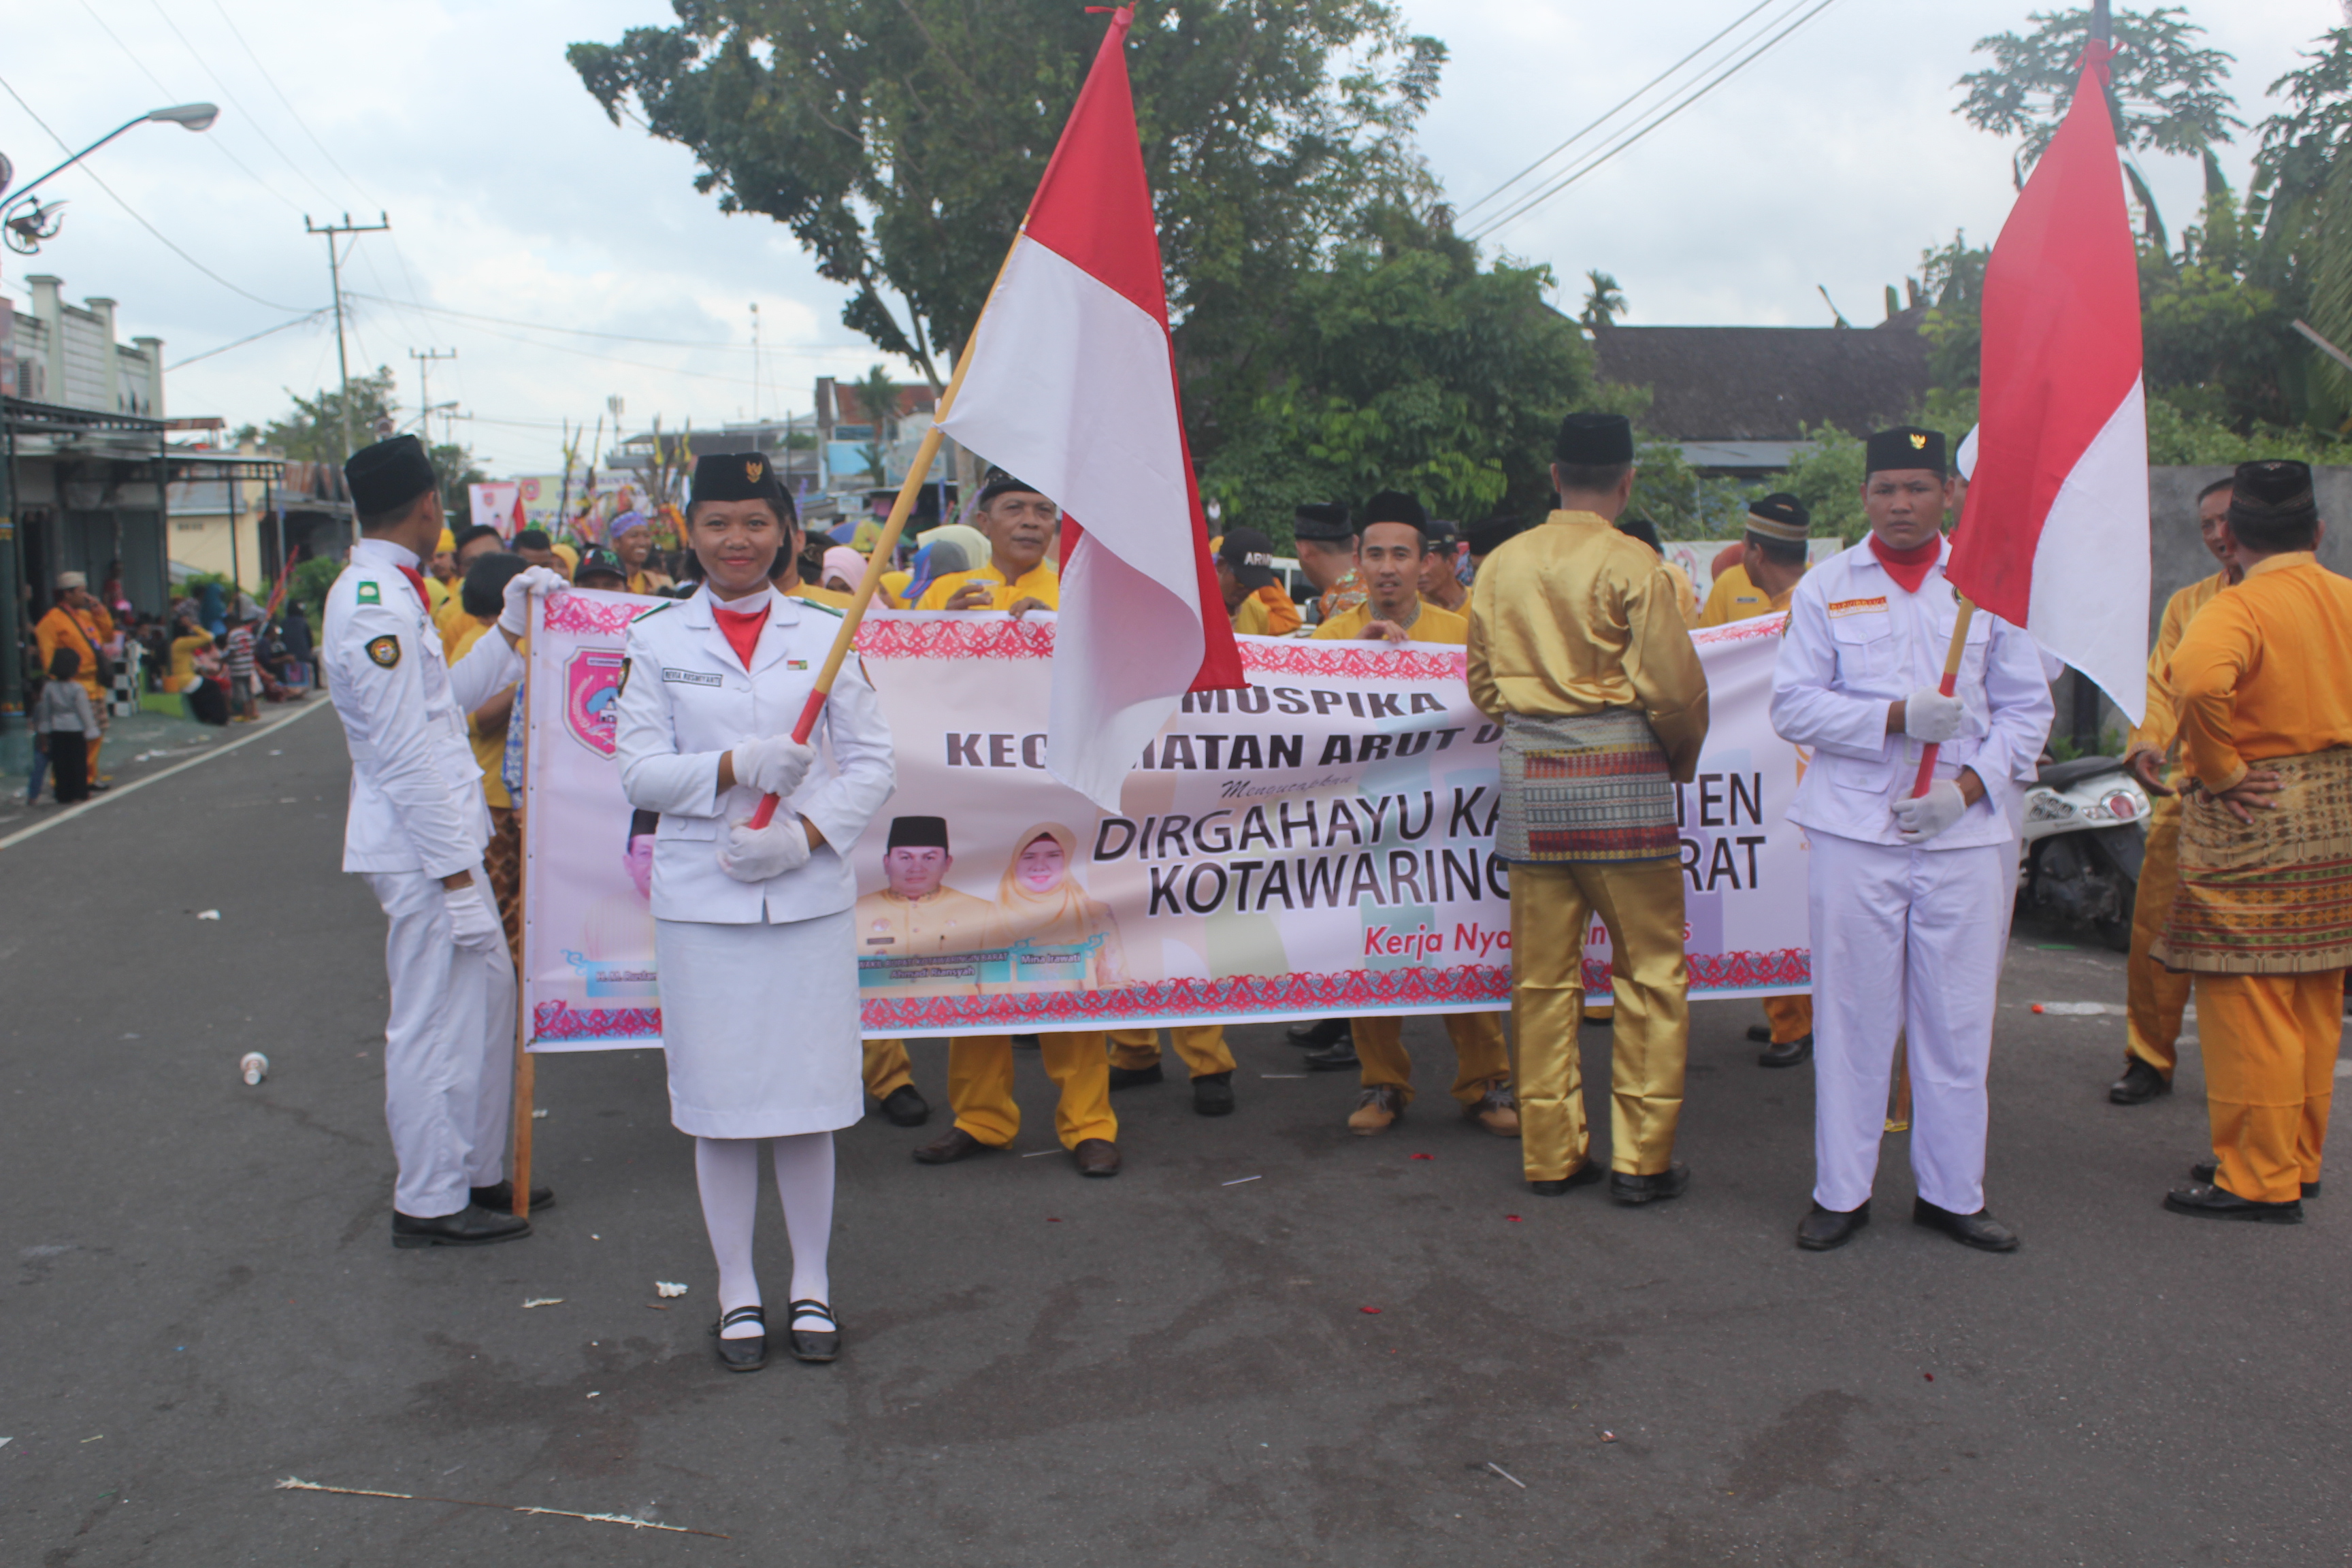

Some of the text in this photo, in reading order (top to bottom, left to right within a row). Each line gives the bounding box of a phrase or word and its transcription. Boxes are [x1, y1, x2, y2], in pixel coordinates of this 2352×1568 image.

[1243, 552, 1273, 566] ARM
[1182, 684, 1448, 719] MUSPIKA
[946, 733, 1303, 770] KECATAN
[1318, 727, 1465, 766] ARUT
[1222, 774, 1352, 799] Mengucapkan
[1094, 791, 1434, 861] DIRGAHAYU
[1149, 836, 1766, 915] KOTAWARING RAT
[1365, 922, 1512, 961] Kerja Nya
[981, 952, 1009, 962] BARAT
[1022, 953, 1081, 964] Mina Irawati
[890, 966, 975, 979] Ahmadi Riansyah
